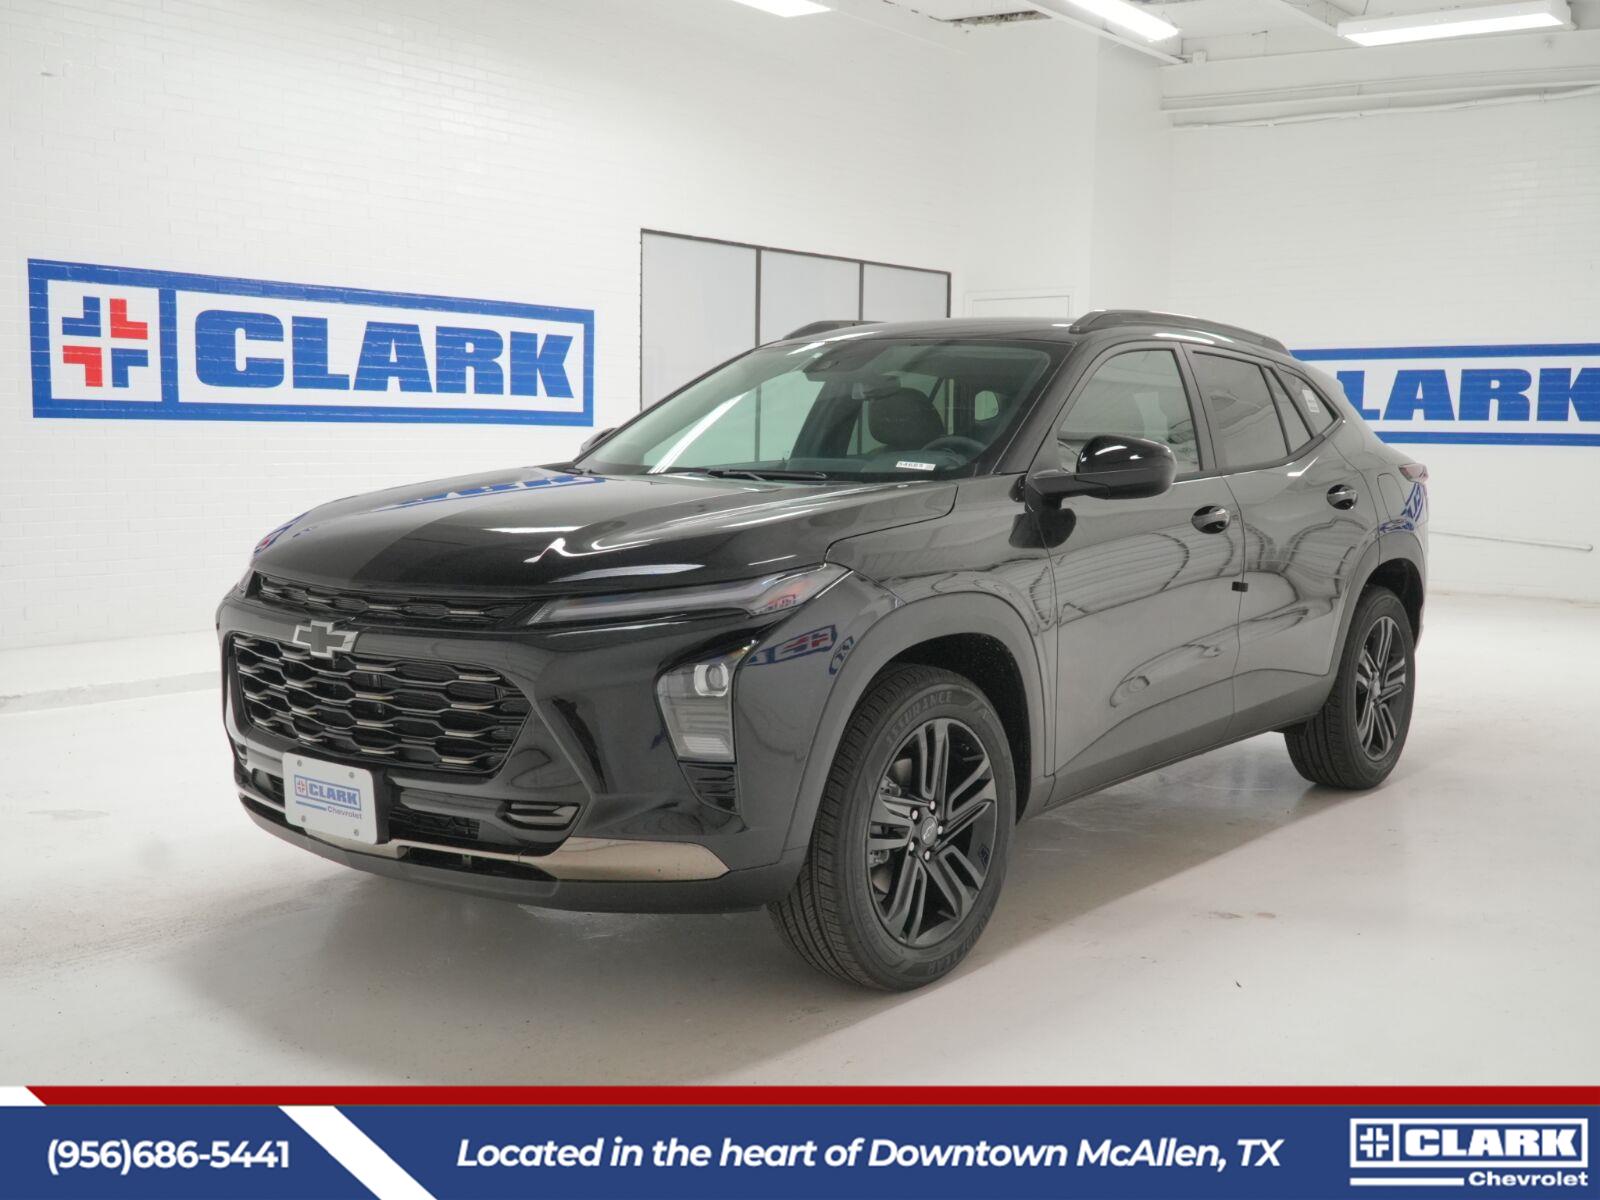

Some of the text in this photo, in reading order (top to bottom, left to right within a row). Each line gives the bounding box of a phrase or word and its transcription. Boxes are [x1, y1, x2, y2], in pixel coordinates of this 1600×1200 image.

[195, 310, 574, 398] CLARK
[1337, 368, 1600, 422] LARK
[309, 783, 358, 805] CLARK
[327, 806, 362, 819] Chevrolet
